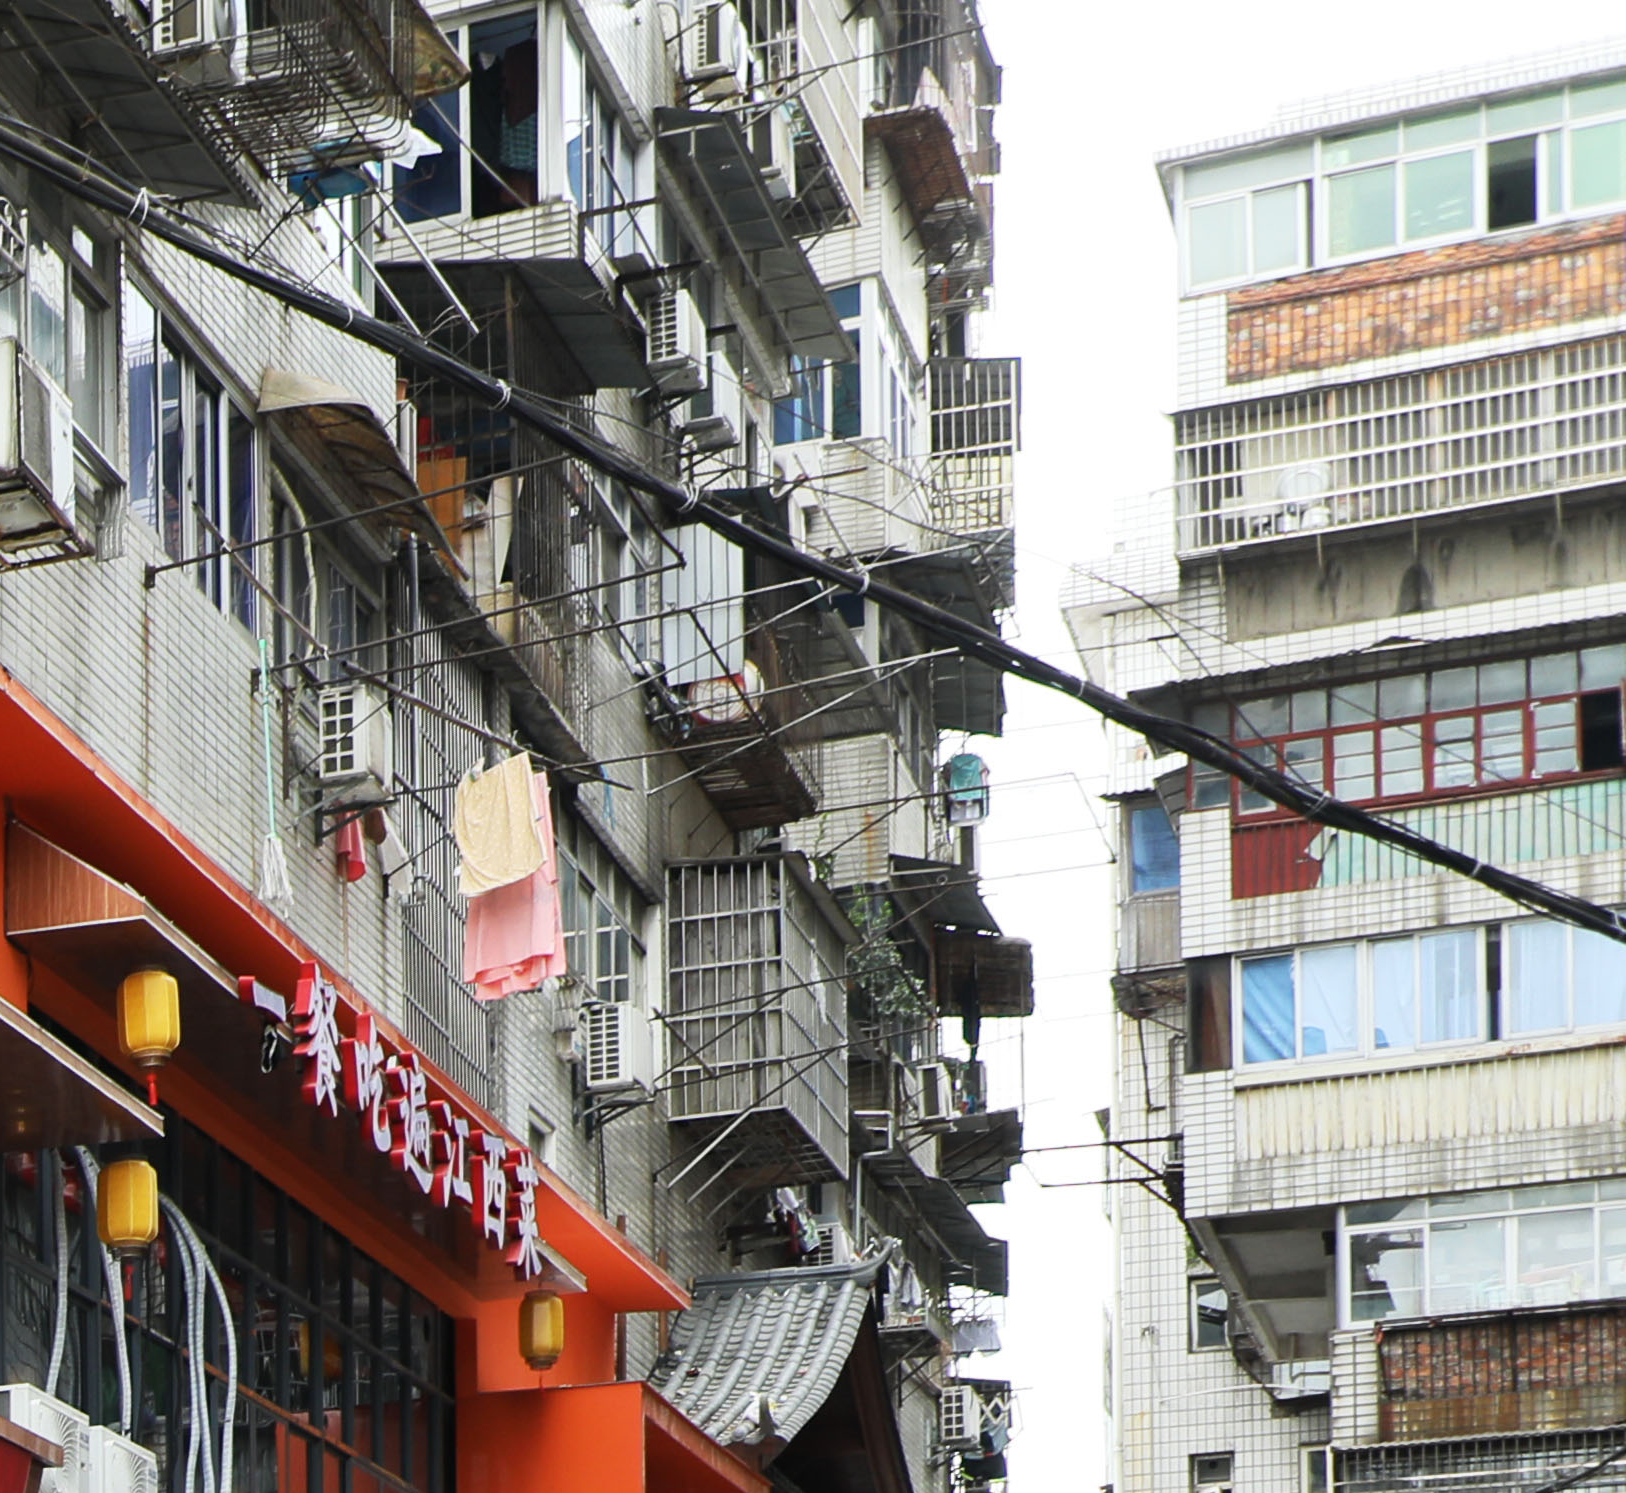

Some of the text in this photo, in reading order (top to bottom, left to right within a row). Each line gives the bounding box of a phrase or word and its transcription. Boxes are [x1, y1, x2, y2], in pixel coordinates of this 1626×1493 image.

[250, 960, 542, 1282] 一餐吃遍江西菜
